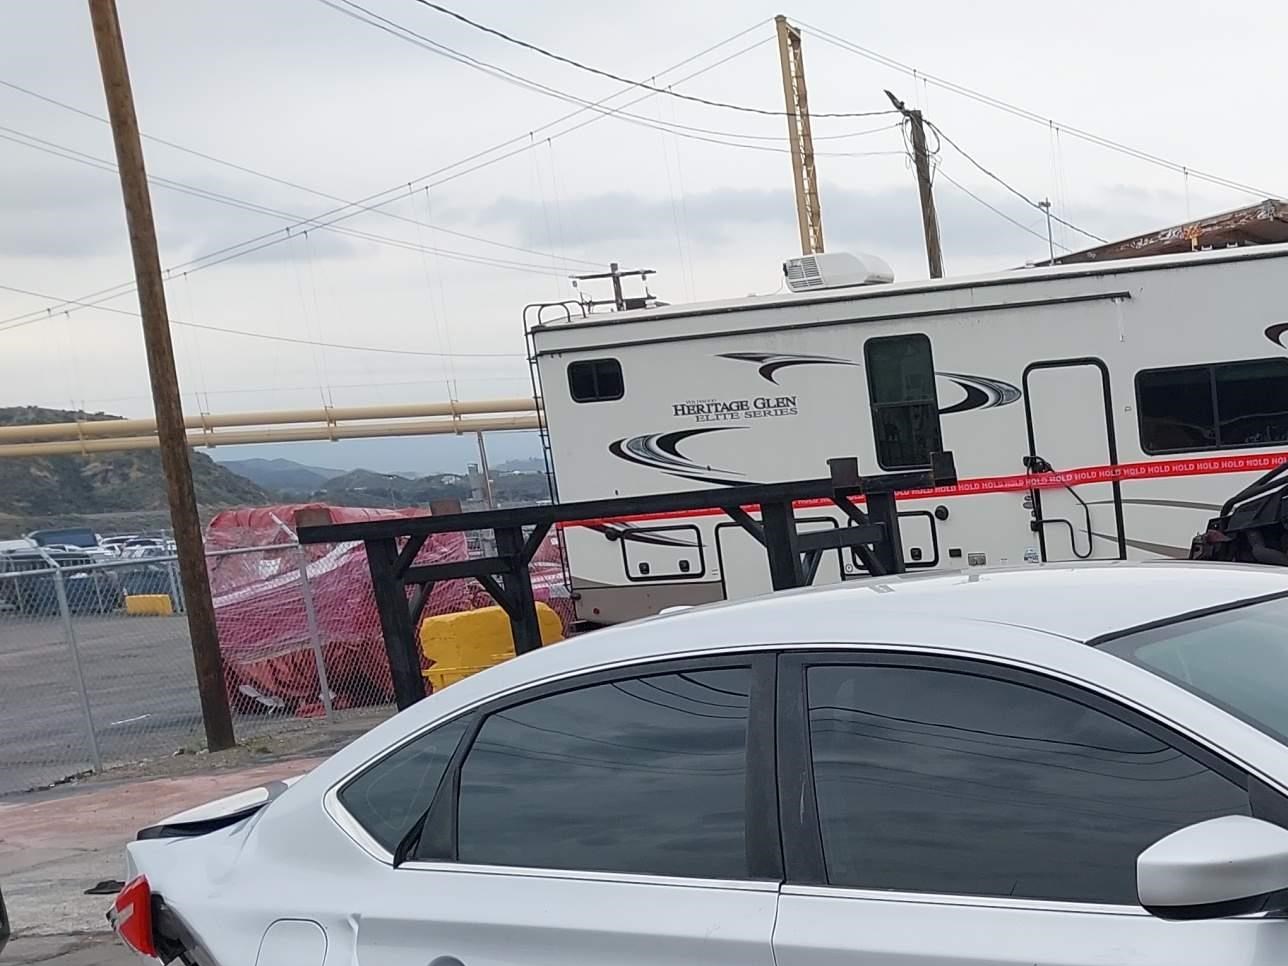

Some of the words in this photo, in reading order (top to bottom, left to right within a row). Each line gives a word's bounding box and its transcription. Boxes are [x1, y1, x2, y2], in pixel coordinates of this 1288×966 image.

[673, 400, 750, 416] HERITAGE
[753, 396, 797, 410] GLEN
[695, 412, 740, 423] ELITE
[743, 408, 798, 419] SERIES
[958, 482, 980, 491] HOLD
[982, 480, 1002, 489] HOLD
[1026, 476, 1048, 486] HOLD
[1050, 474, 1073, 482] HOLD
[1075, 470, 1096, 480] HOLD
[1100, 468, 1120, 477] HOLD
[1124, 466, 1146, 476] HOLD
[1148, 464, 1170, 474] HOLD
[1172, 462, 1194, 472] HOLD
[1196, 461, 1219, 470] HOLD
[1221, 460, 1244, 468] HOLD
[1246, 457, 1268, 467] HOLD
